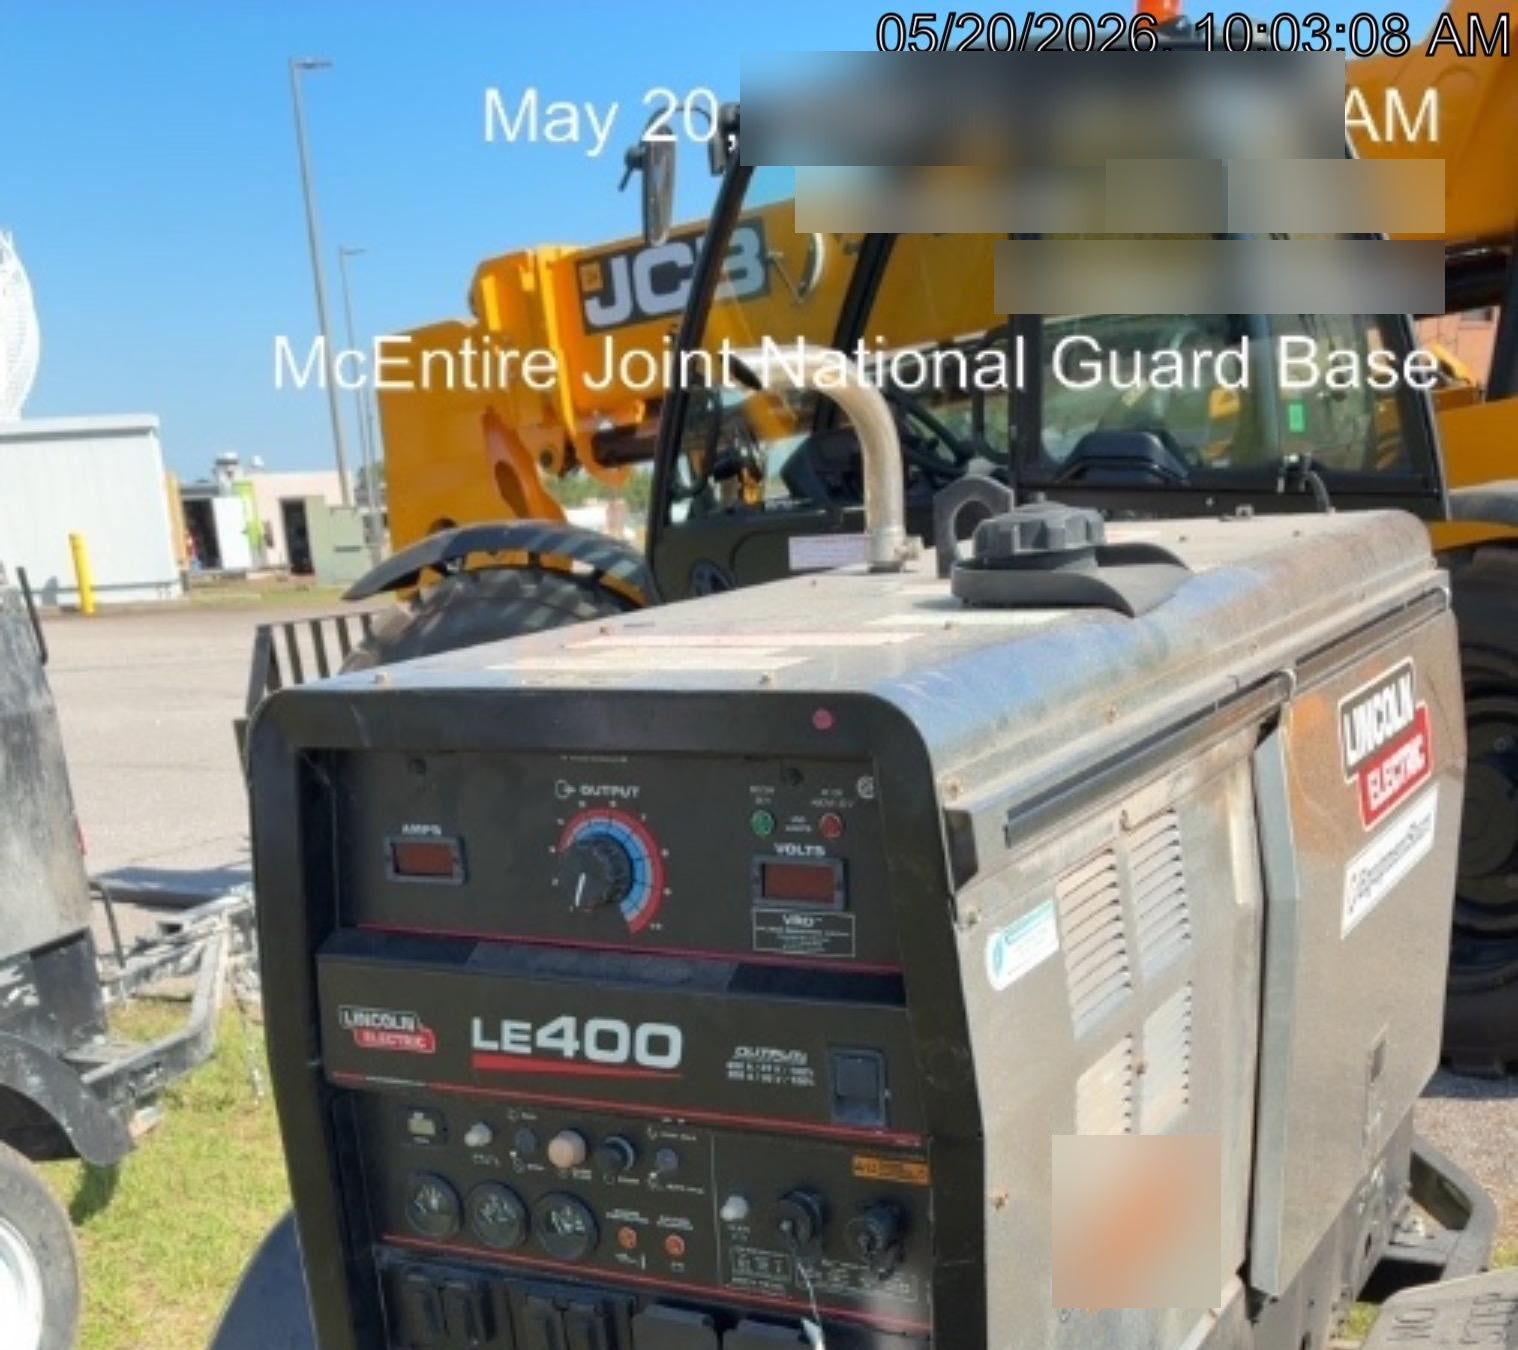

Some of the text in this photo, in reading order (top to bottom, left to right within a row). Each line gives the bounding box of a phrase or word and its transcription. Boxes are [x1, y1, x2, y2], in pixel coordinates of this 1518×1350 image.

[583, 226, 766, 328] JCB
[1343, 670, 1415, 768] LINCOLN
[579, 785, 641, 799] OUTPUT
[401, 823, 442, 836] AMPS
[773, 842, 826, 857] VOLTS
[343, 1010, 416, 1033] LINCOLN
[361, 1032, 428, 1049] ELECTRIC
[471, 1014, 683, 1069] LE400
